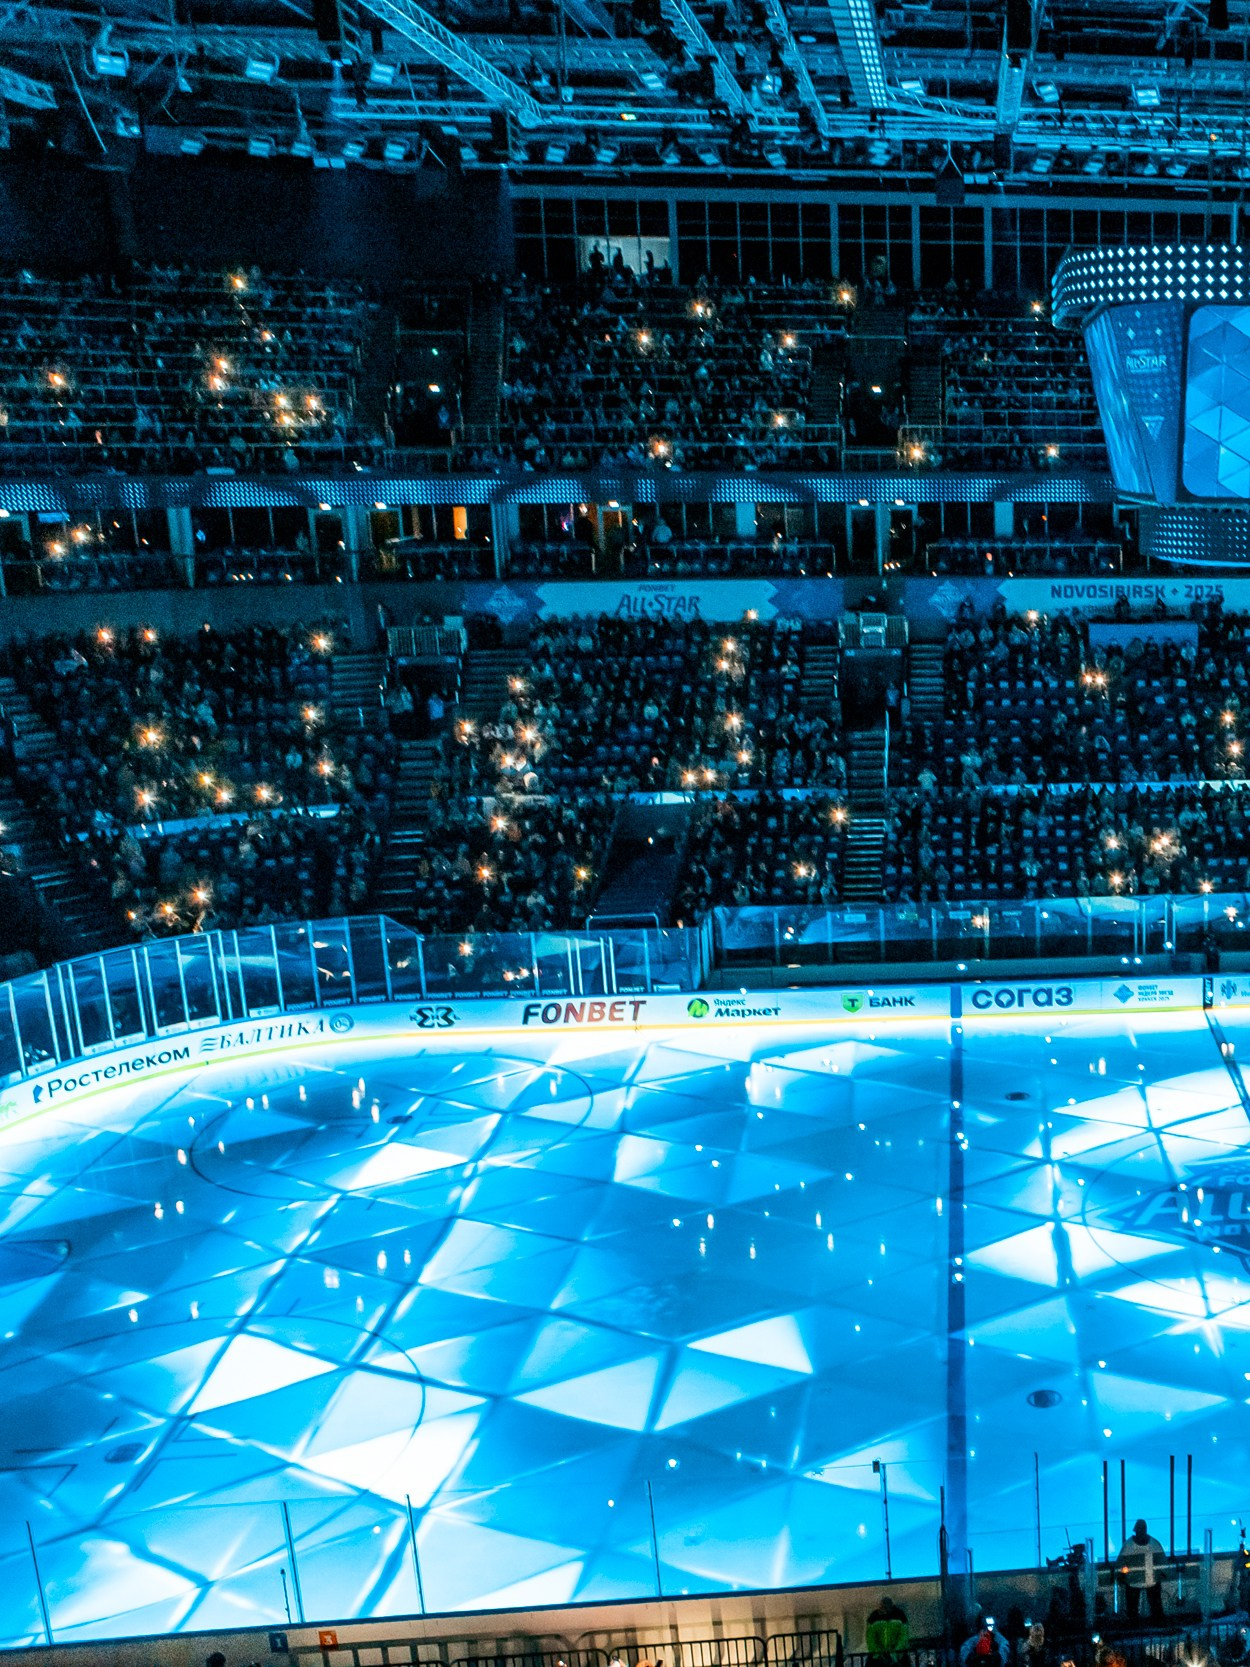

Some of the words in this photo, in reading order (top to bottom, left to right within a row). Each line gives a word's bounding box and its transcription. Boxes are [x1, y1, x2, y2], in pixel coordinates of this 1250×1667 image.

[1051, 584, 1166, 599] NOVOSIBIRSK
[1184, 585, 1224, 599] 2025
[714, 1006, 781, 1018] Маркет
[869, 996, 915, 1008] БАНК
[522, 1000, 647, 1025] FONBET
[220, 1018, 324, 1050] БАЛТИКА
[47, 1046, 190, 1098] Ростелеком
